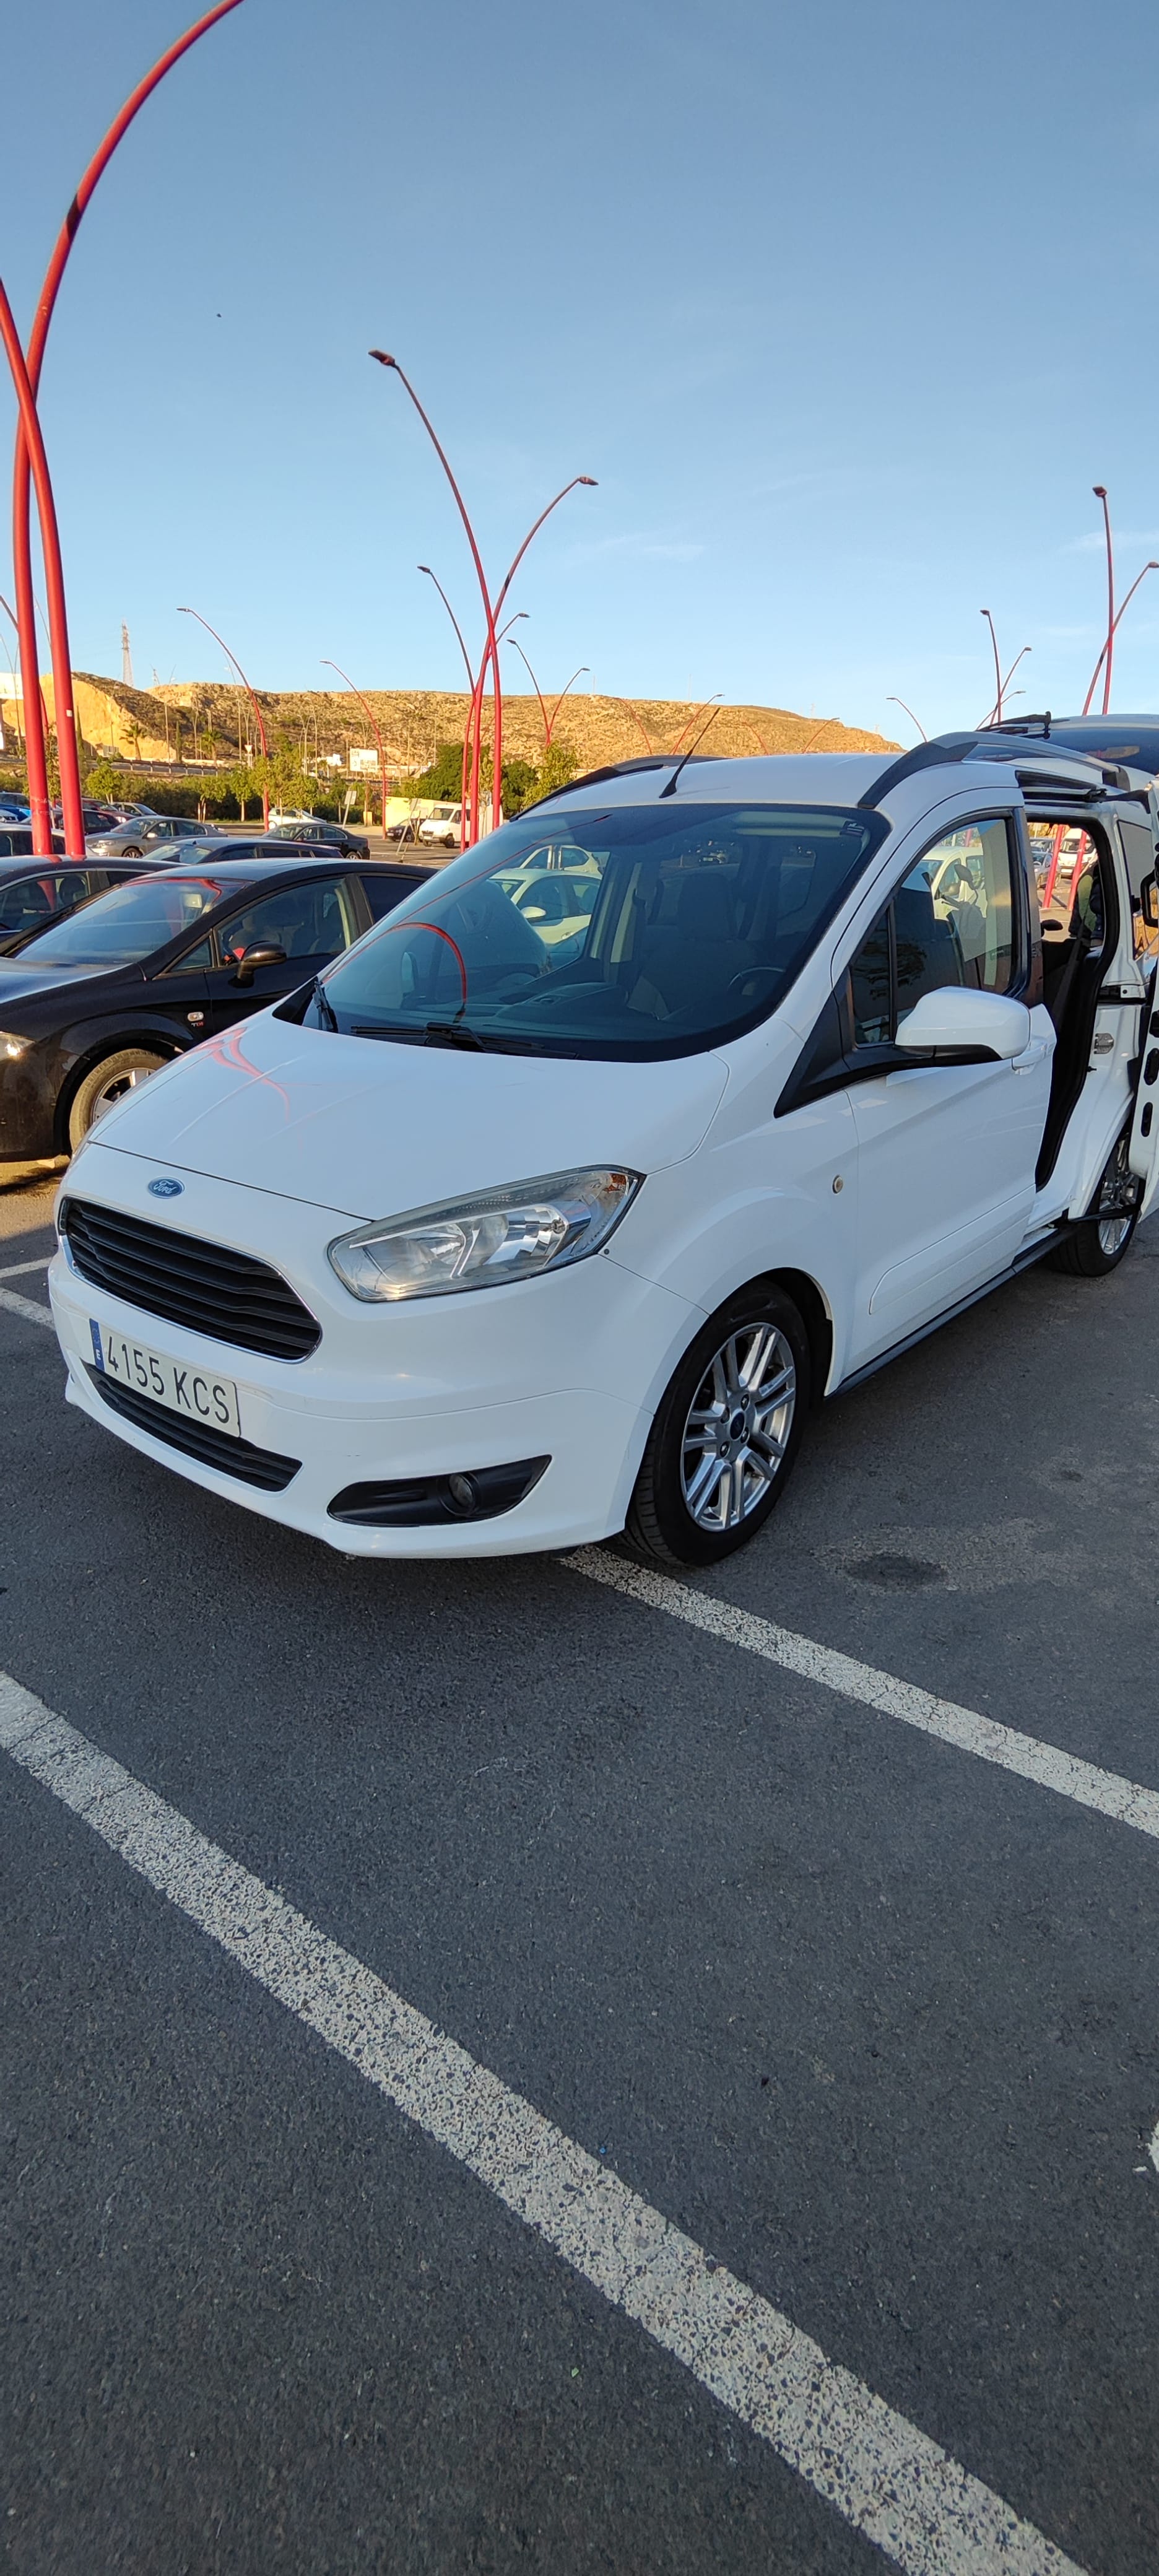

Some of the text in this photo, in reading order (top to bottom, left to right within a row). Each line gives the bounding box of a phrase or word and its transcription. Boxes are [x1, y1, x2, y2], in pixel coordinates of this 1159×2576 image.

[153, 1180, 177, 1194] Ford
[95, 1349, 102, 1360] E
[108, 1336, 230, 1424] 4155 KCS
